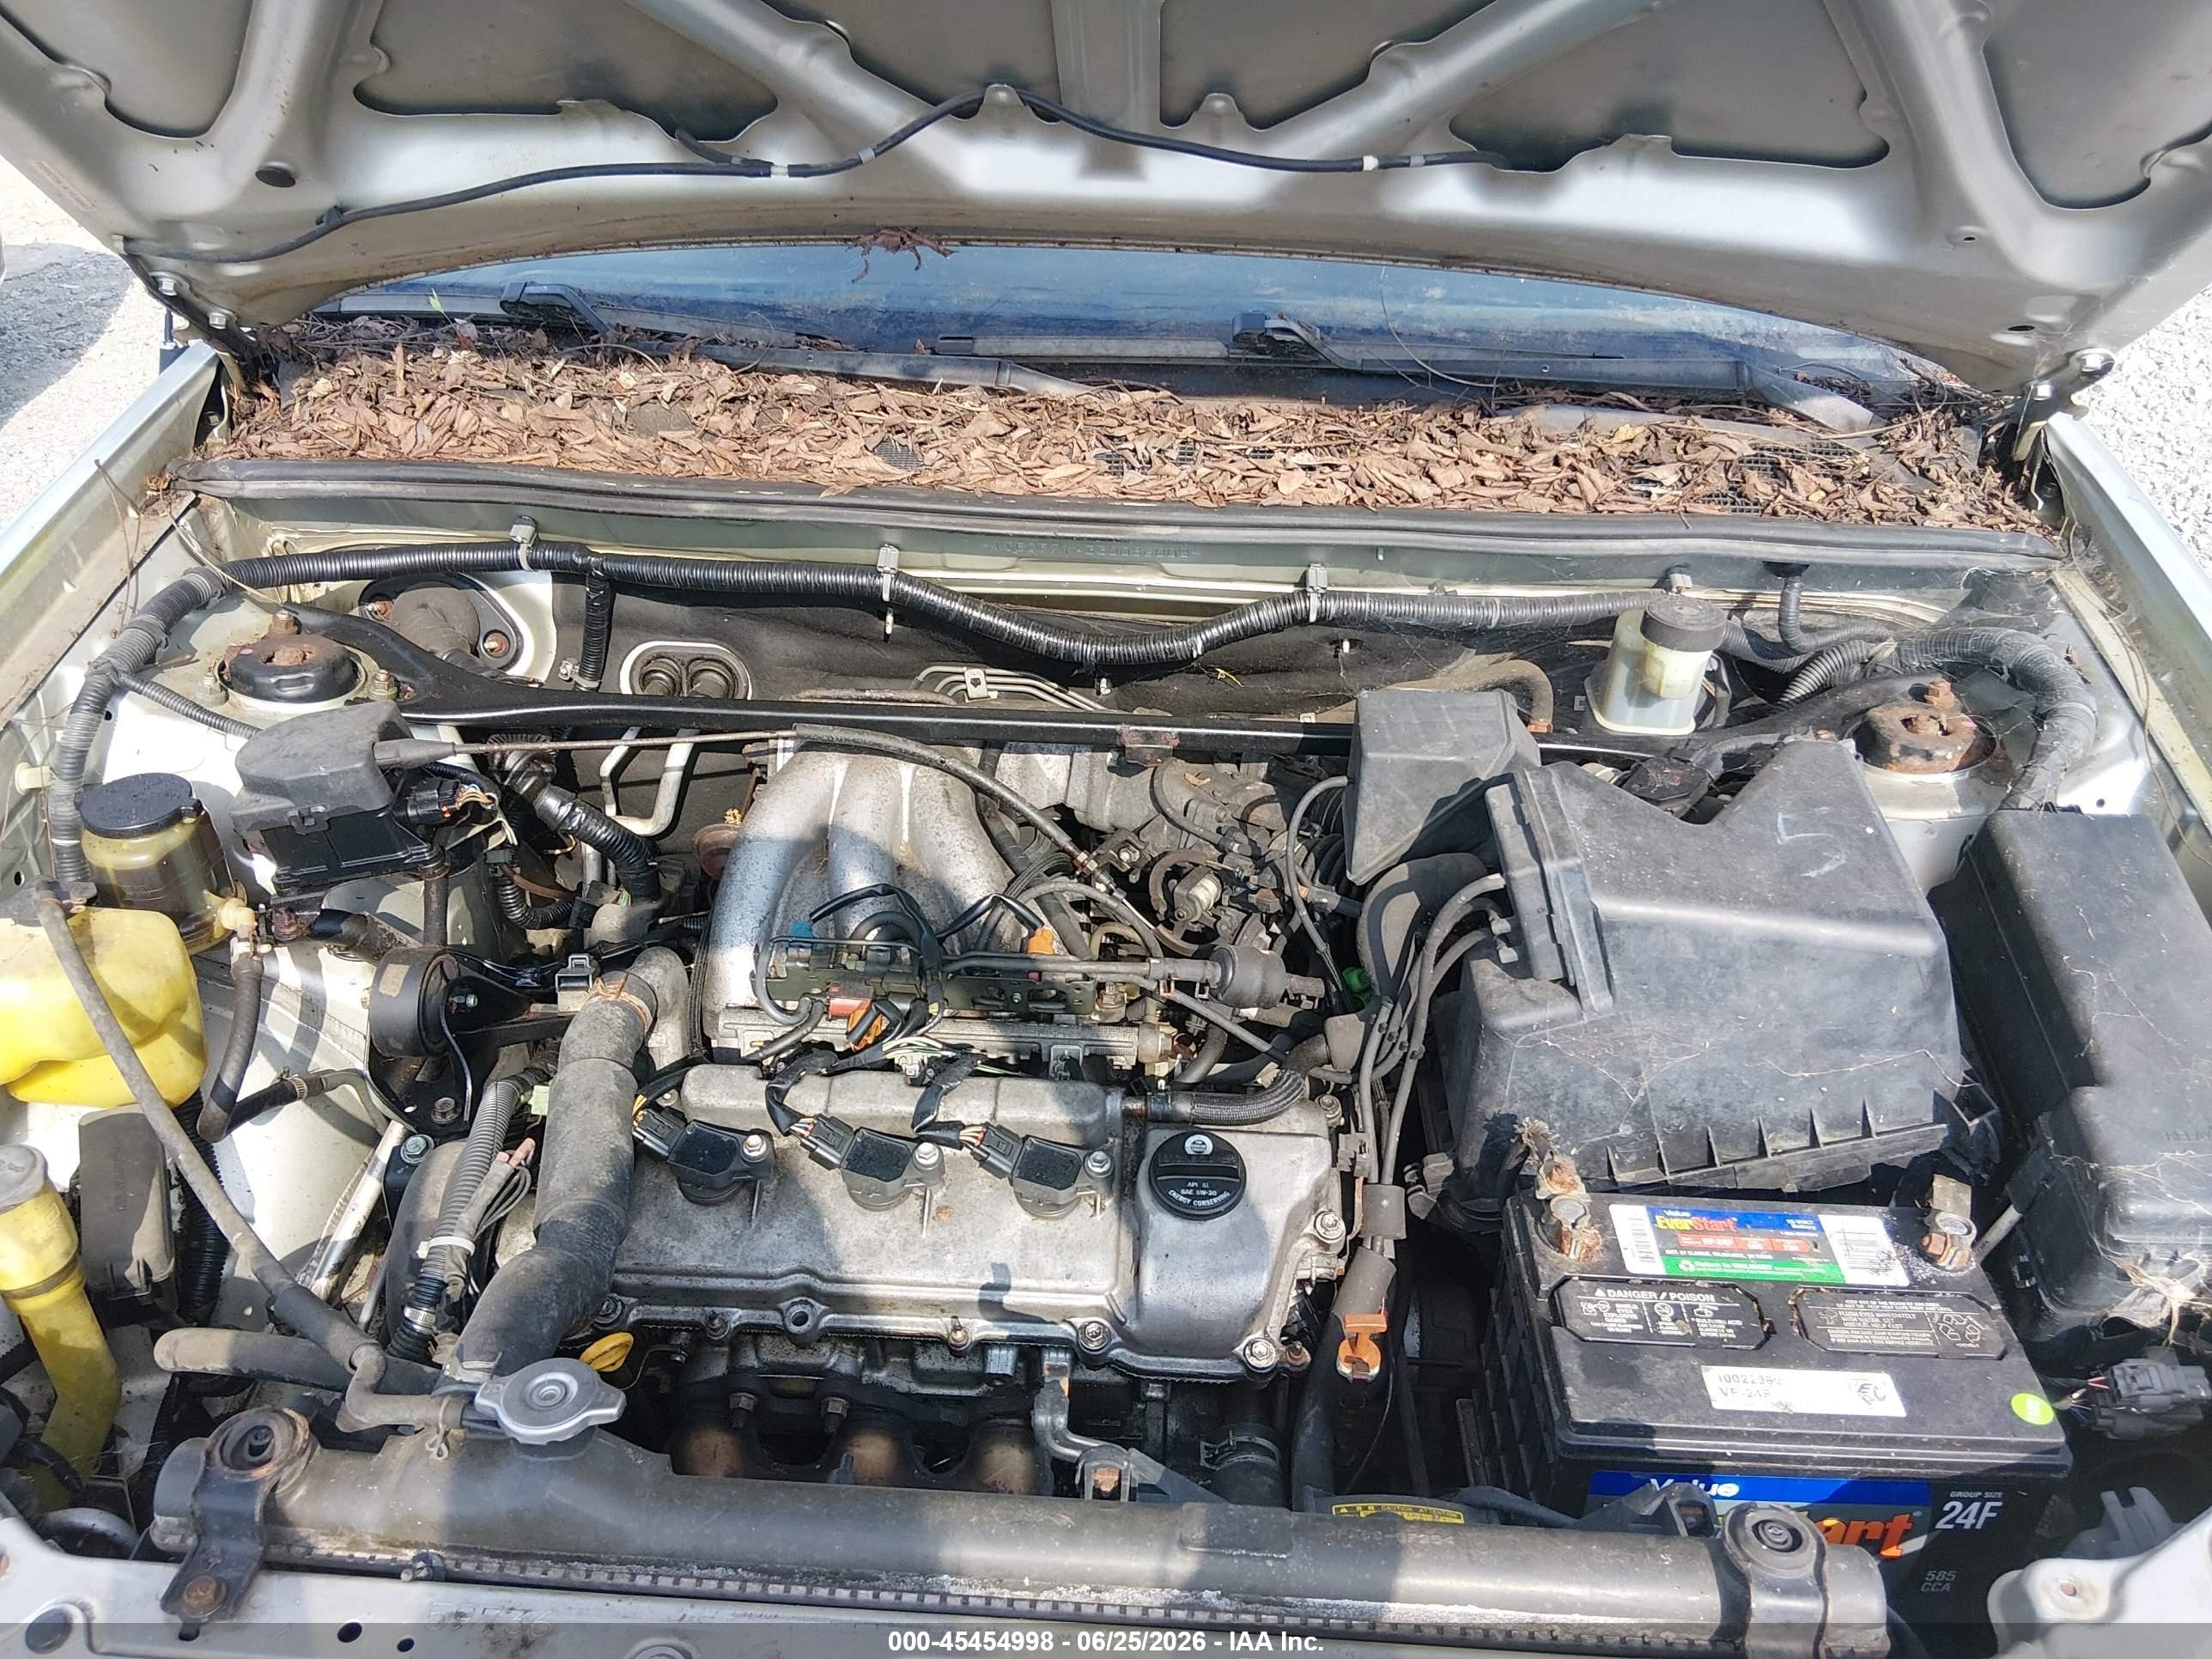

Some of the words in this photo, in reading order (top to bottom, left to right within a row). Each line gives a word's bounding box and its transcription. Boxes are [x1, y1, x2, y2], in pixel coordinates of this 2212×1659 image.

[1168, 1188, 1192, 1206] ENERGY
[1193, 1190, 1231, 1207] CONSERVING
[1607, 1290, 1658, 1300] DANGER
[1669, 1292, 1716, 1303] POISON
[1649, 1478, 1741, 1498] Vlue
[1935, 1500, 2003, 1530] 24F
[1924, 1570, 1958, 1582] 585
[1920, 1582, 1952, 1593] CCA
